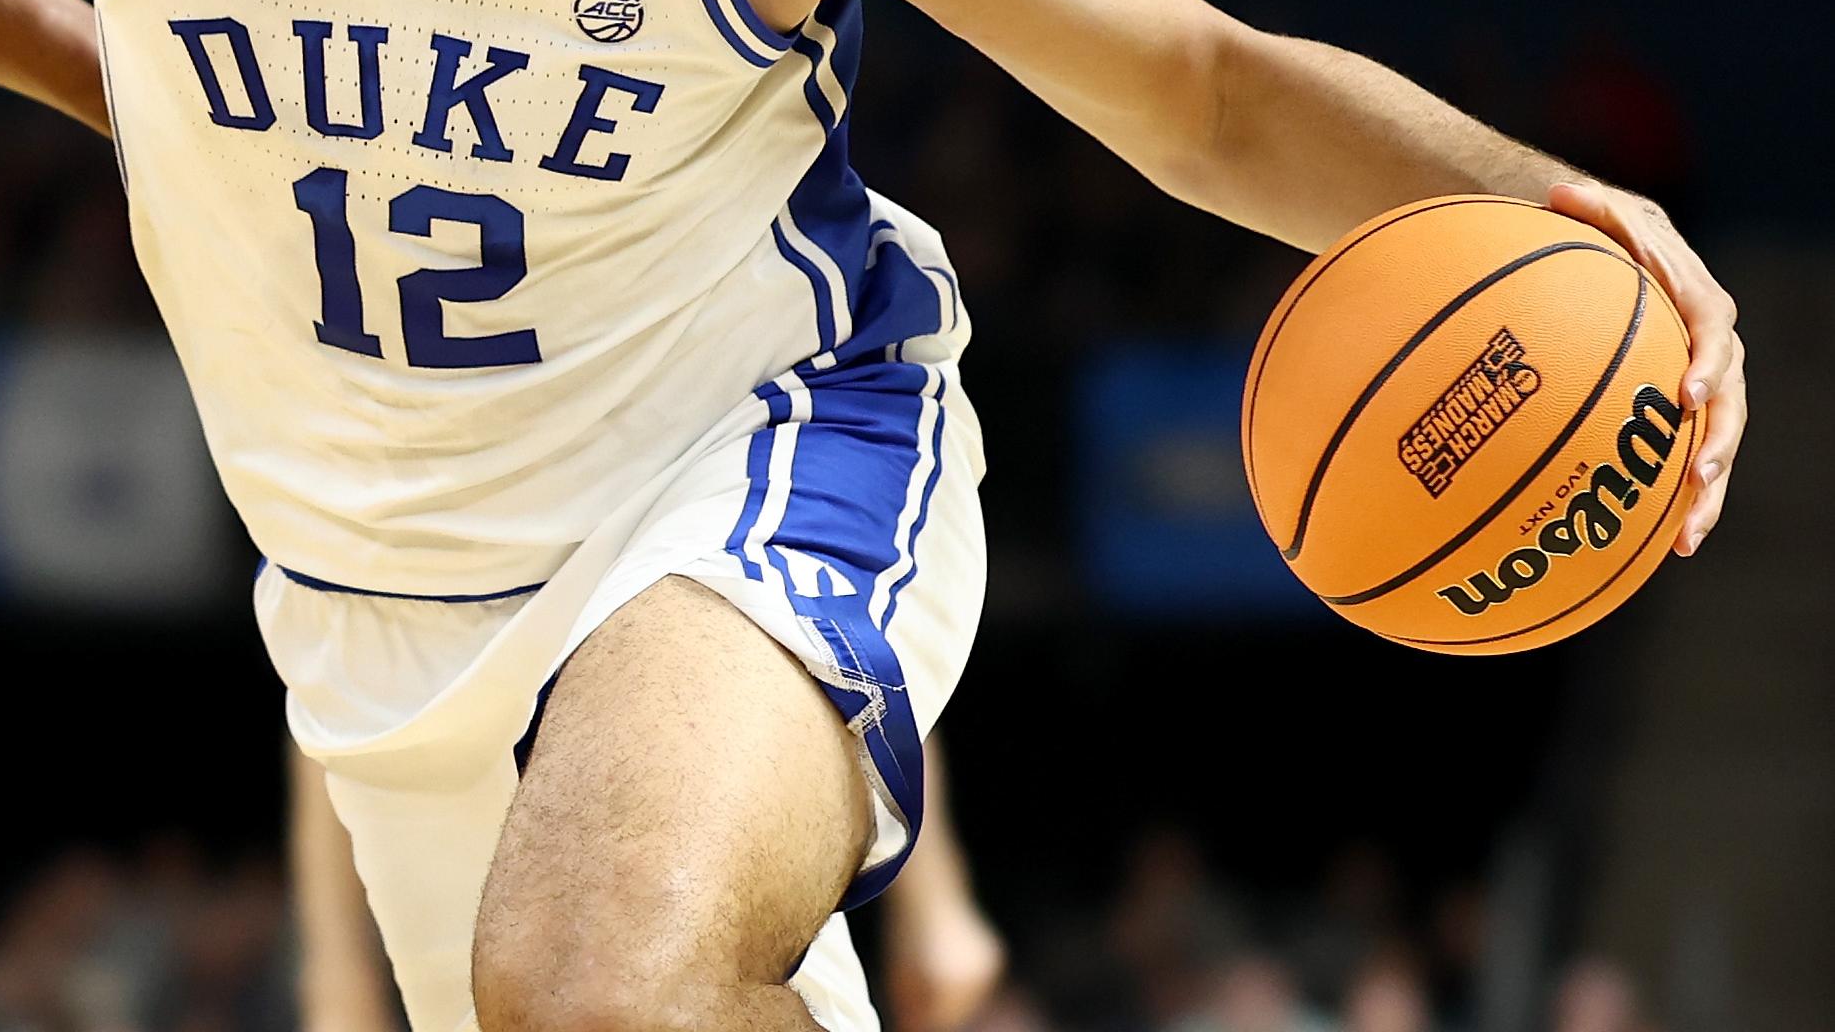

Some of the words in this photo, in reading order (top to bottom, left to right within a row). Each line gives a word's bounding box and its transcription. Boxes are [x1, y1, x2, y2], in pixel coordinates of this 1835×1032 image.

[583, 1, 641, 18] ACC
[168, 16, 665, 182] DUKE
[292, 166, 543, 369] 12
[1401, 370, 1495, 471] MADNESS
[1447, 381, 1522, 460] MARCH
[1435, 383, 1684, 615] Wilson
[1519, 501, 1554, 536] NXT
[1556, 461, 1589, 500] EVO
